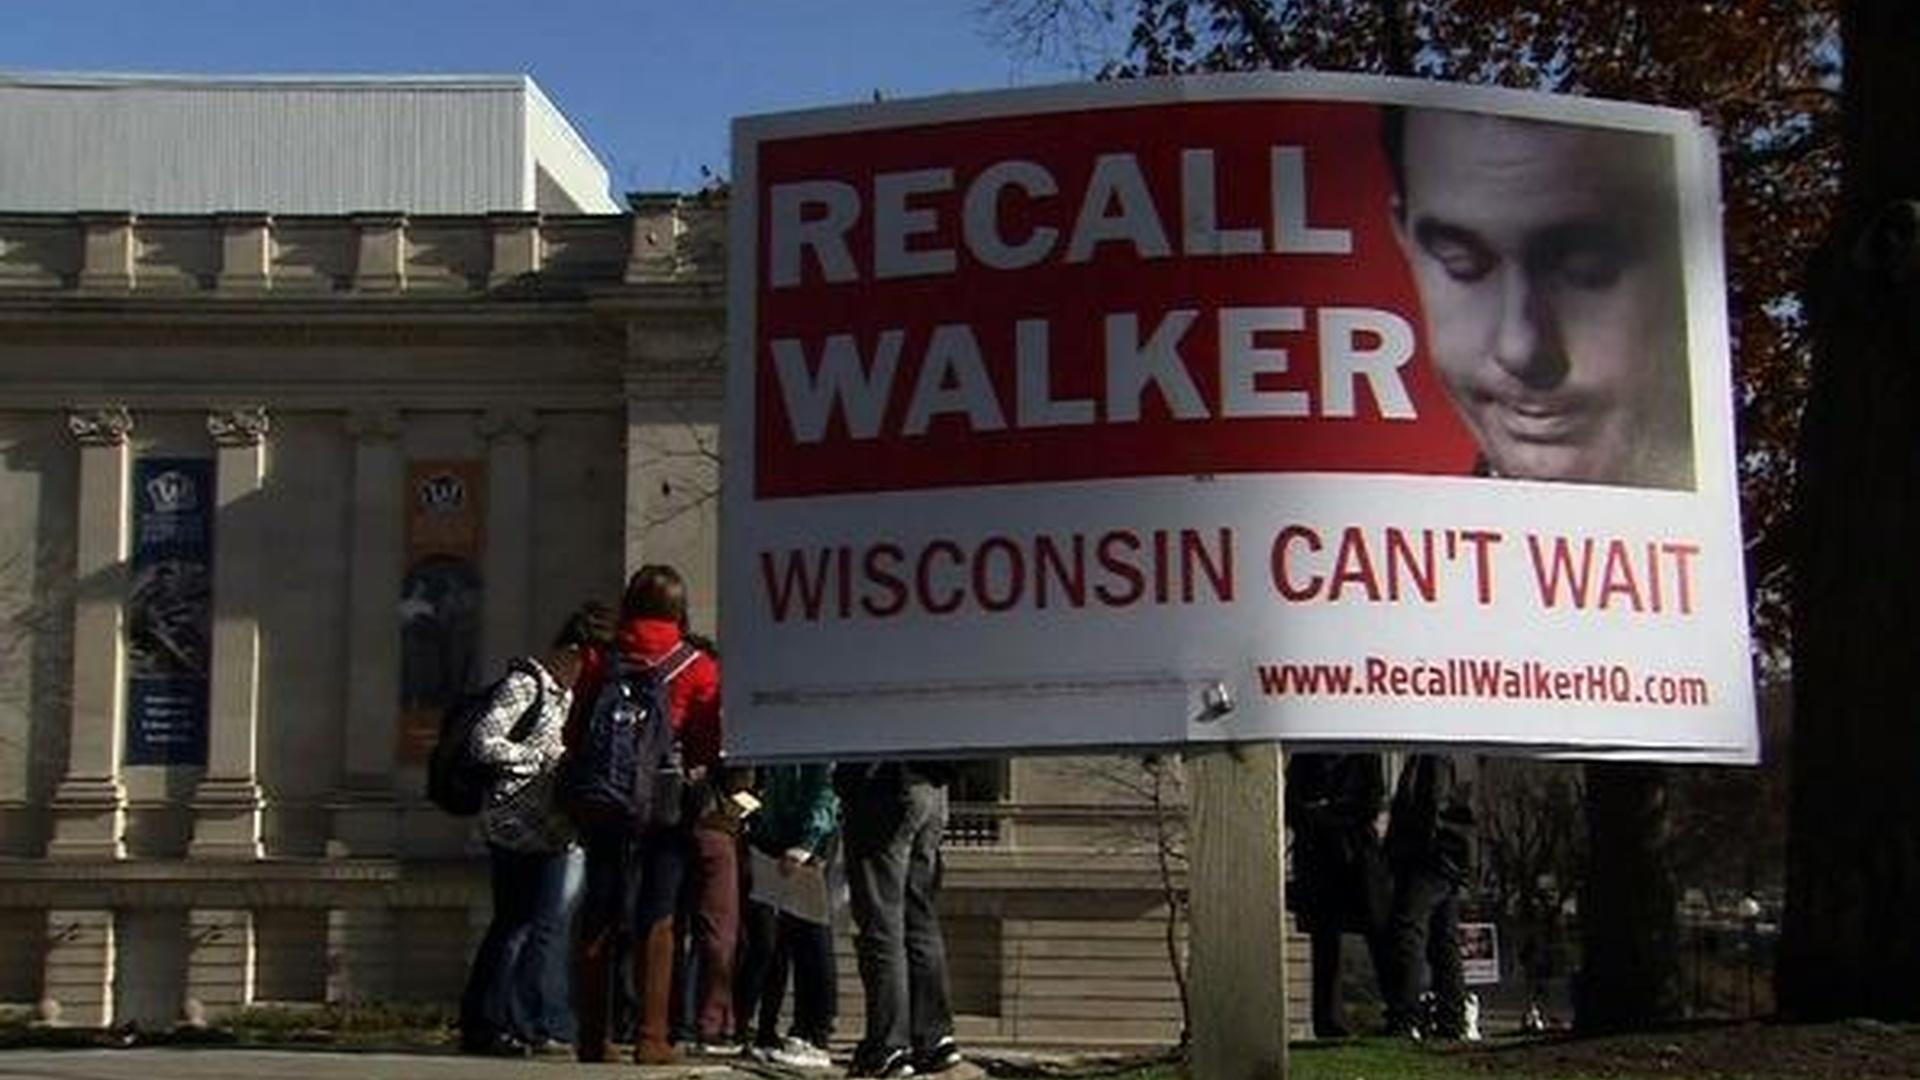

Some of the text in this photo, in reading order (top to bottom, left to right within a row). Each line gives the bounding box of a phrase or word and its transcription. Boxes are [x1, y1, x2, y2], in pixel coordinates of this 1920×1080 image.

[770, 145, 1353, 289] RECALL
[772, 306, 1418, 444] WALKER
[760, 525, 1702, 623] WISCONSIN CAN'T WAIT
[1258, 656, 1710, 706] www.RecallWalkerHQ.com
